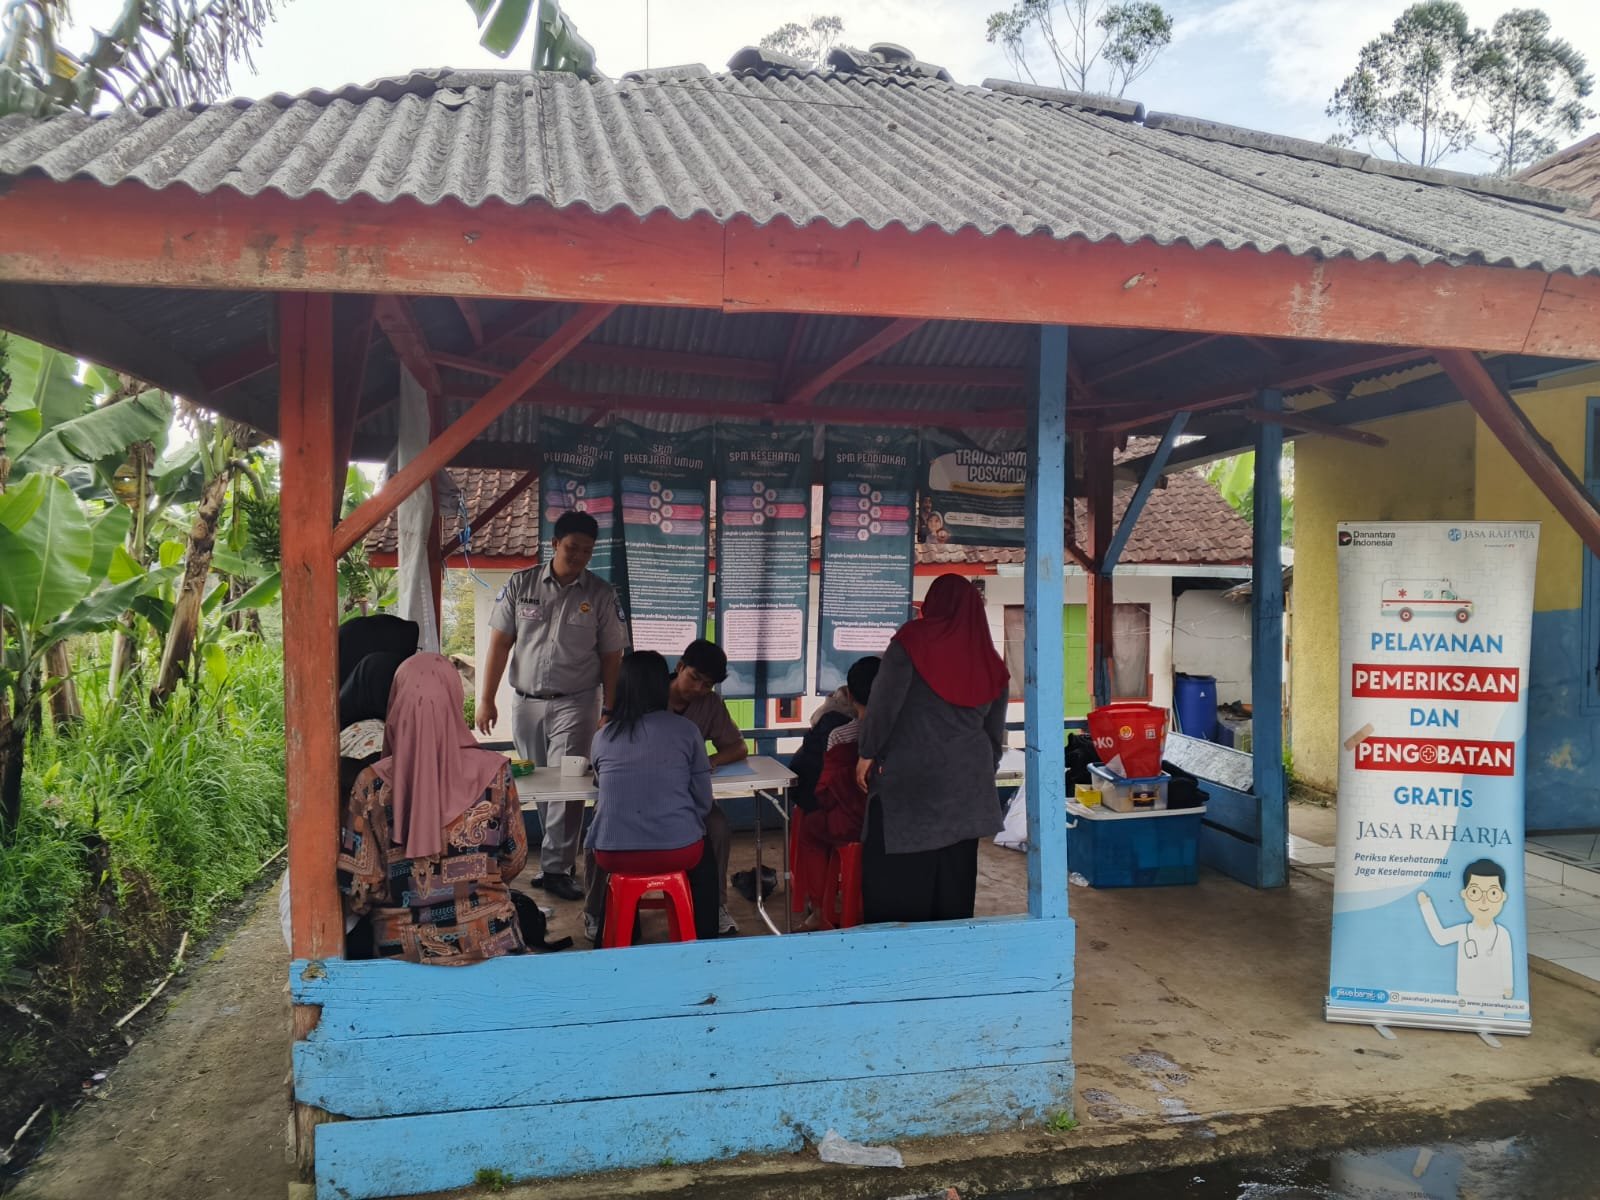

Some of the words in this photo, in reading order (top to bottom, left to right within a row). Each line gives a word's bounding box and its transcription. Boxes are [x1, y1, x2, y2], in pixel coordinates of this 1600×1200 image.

[623, 453, 672, 465] PEKERJAAN
[674, 456, 704, 470] UMUM
[729, 451, 749, 462] SPM
[751, 451, 800, 463] KESEHATAN
[836, 453, 855, 464] SPM
[857, 453, 907, 466] PENDIDIKAN
[956, 449, 1026, 467] TRANSFORM
[969, 465, 1026, 483] POSYAND
[1353, 531, 1396, 539] Danantara
[1353, 538, 1393, 547] Indonesia
[1464, 529, 1486, 539] JASA
[1489, 530, 1535, 539] RAHARJA
[1371, 632, 1503, 654] PELAYANAN
[1355, 670, 1516, 694] PEMERIKSAAN
[1410, 708, 1459, 728] DAN
[1394, 786, 1473, 808] GRATIS
[1356, 821, 1403, 840] JASA
[1410, 823, 1513, 848] RAHARJA
[1354, 852, 1387, 863] Periksa
[1389, 853, 1449, 865] Kesehatanmu
[1355, 866, 1376, 877] Jaga
[1378, 867, 1451, 879] Keselamatanmu!
